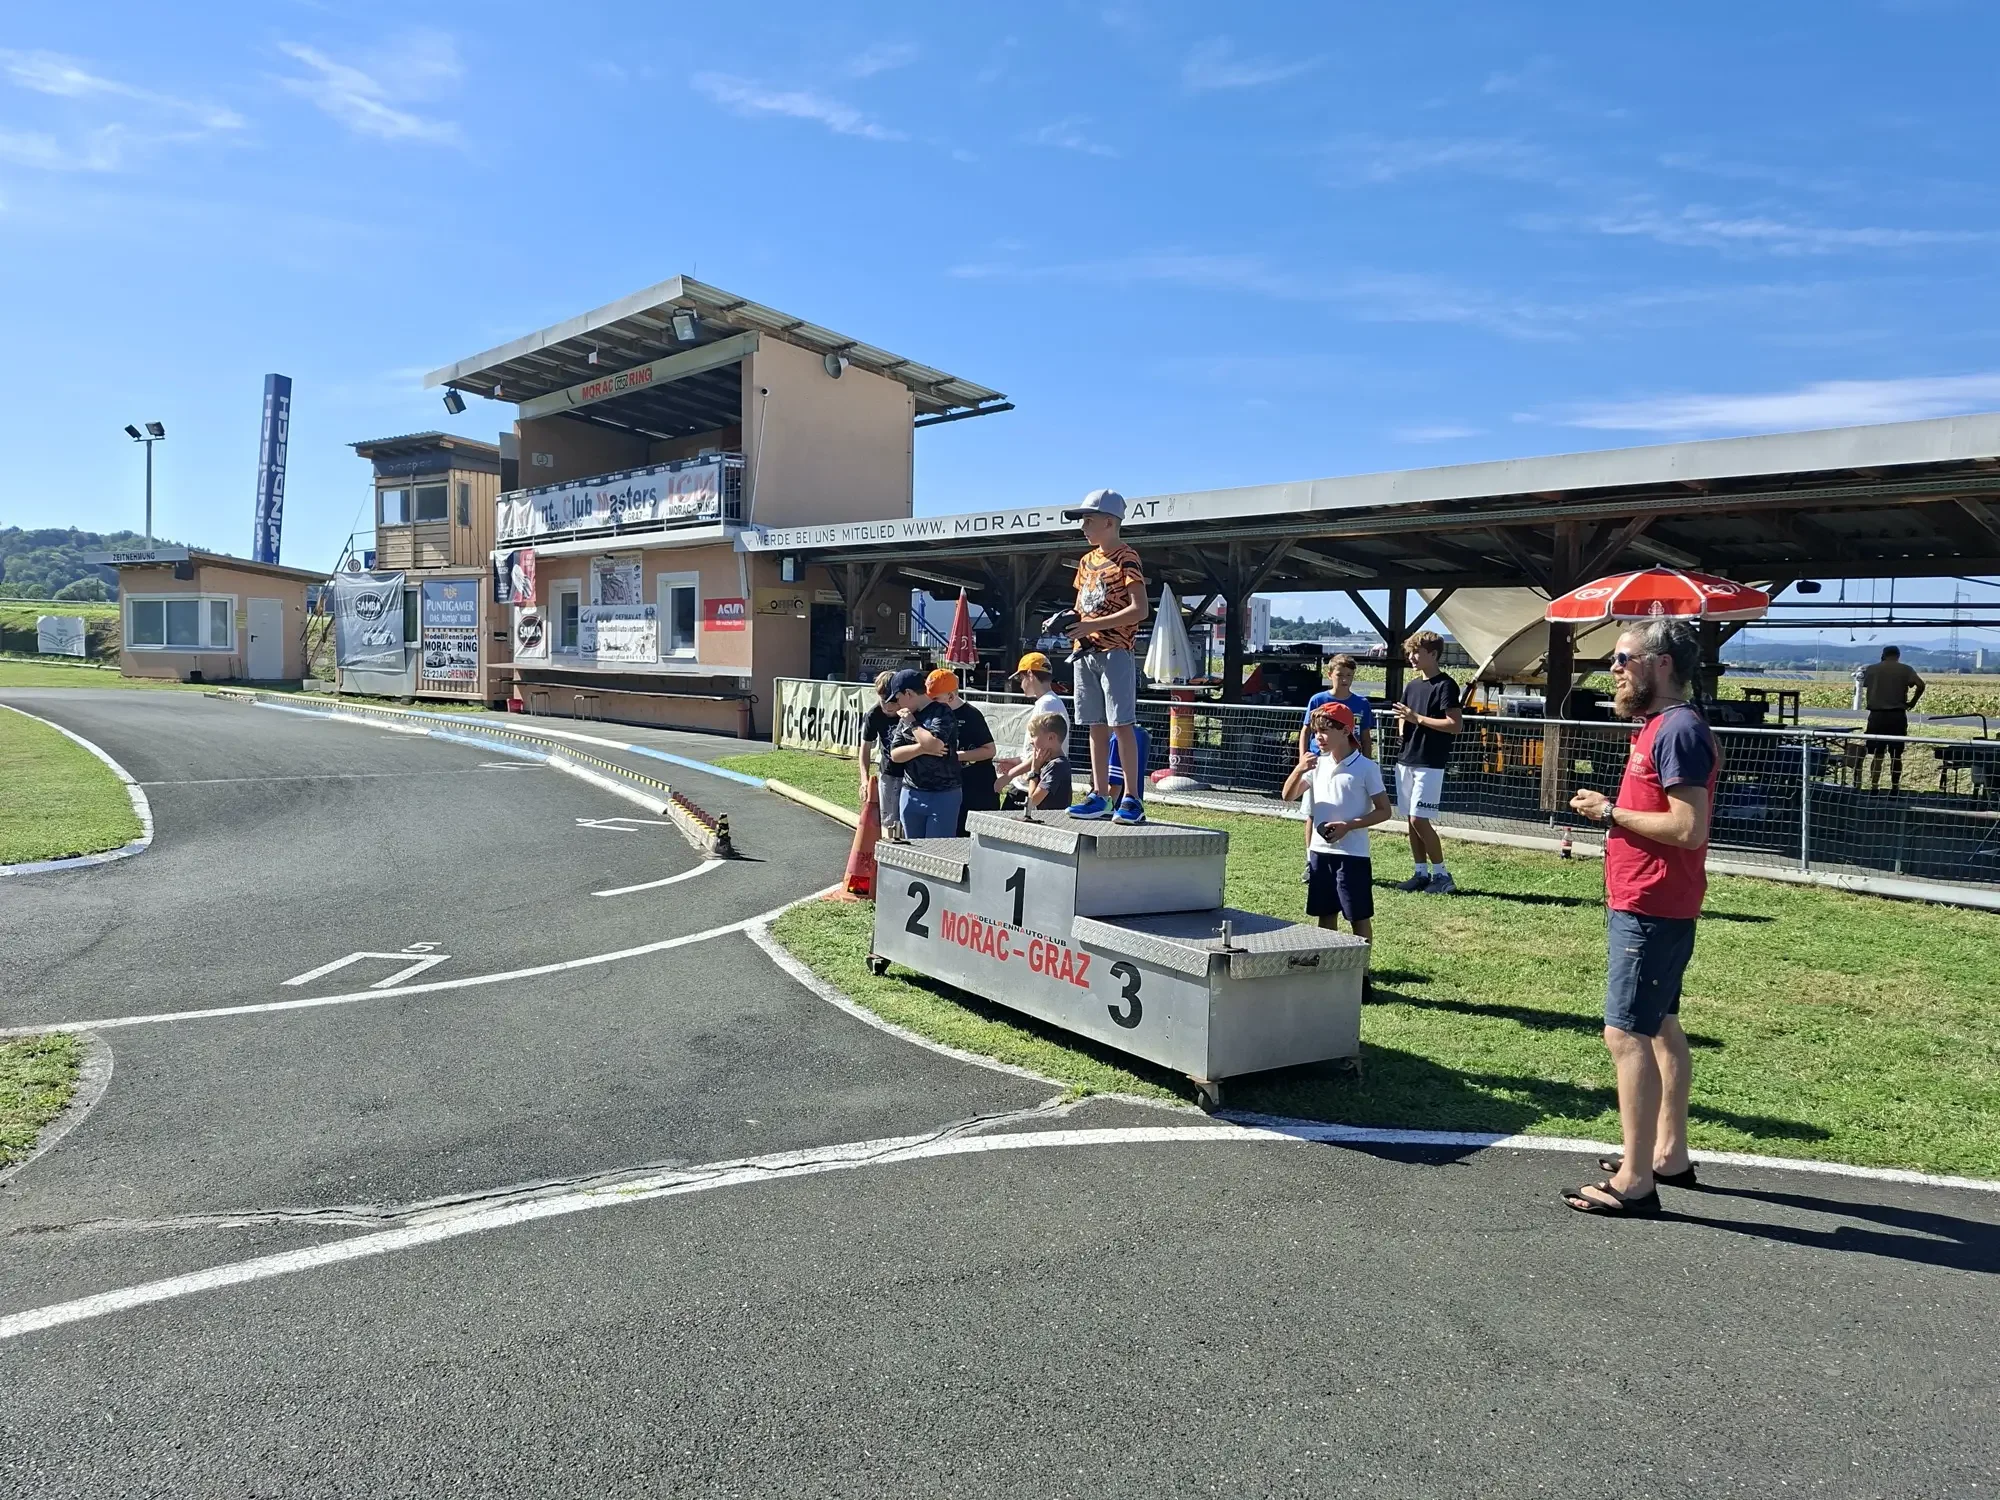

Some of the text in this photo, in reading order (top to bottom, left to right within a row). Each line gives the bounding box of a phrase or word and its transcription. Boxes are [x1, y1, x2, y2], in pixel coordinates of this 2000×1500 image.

[582, 379, 614, 400] MORAC
[629, 368, 652, 386] RING
[541, 499, 558, 523] nt.
[563, 492, 593, 521] Club
[597, 485, 657, 515] Masters
[755, 533, 790, 547] WERDE
[796, 531, 811, 544] BEI
[816, 529, 836, 542] UNS
[843, 525, 895, 540] MITGLIED
[903, 520, 946, 537] WWW.
[112, 551, 156, 562] ZEITNEHMUNG
[356, 601, 381, 611] SAMBA
[426, 599, 475, 611] PUNTIGAMER
[424, 633, 478, 641] ModellRennSport
[424, 641, 478, 652] MORAC RING
[451, 669, 477, 679] RENNEN
[1005, 866, 1026, 927] 1
[905, 881, 931, 939] 2
[967, 912, 1067, 947] MODELLRENNAUTOCLUB
[401, 942, 442, 952] 5
[1107, 960, 1143, 1029] 3
